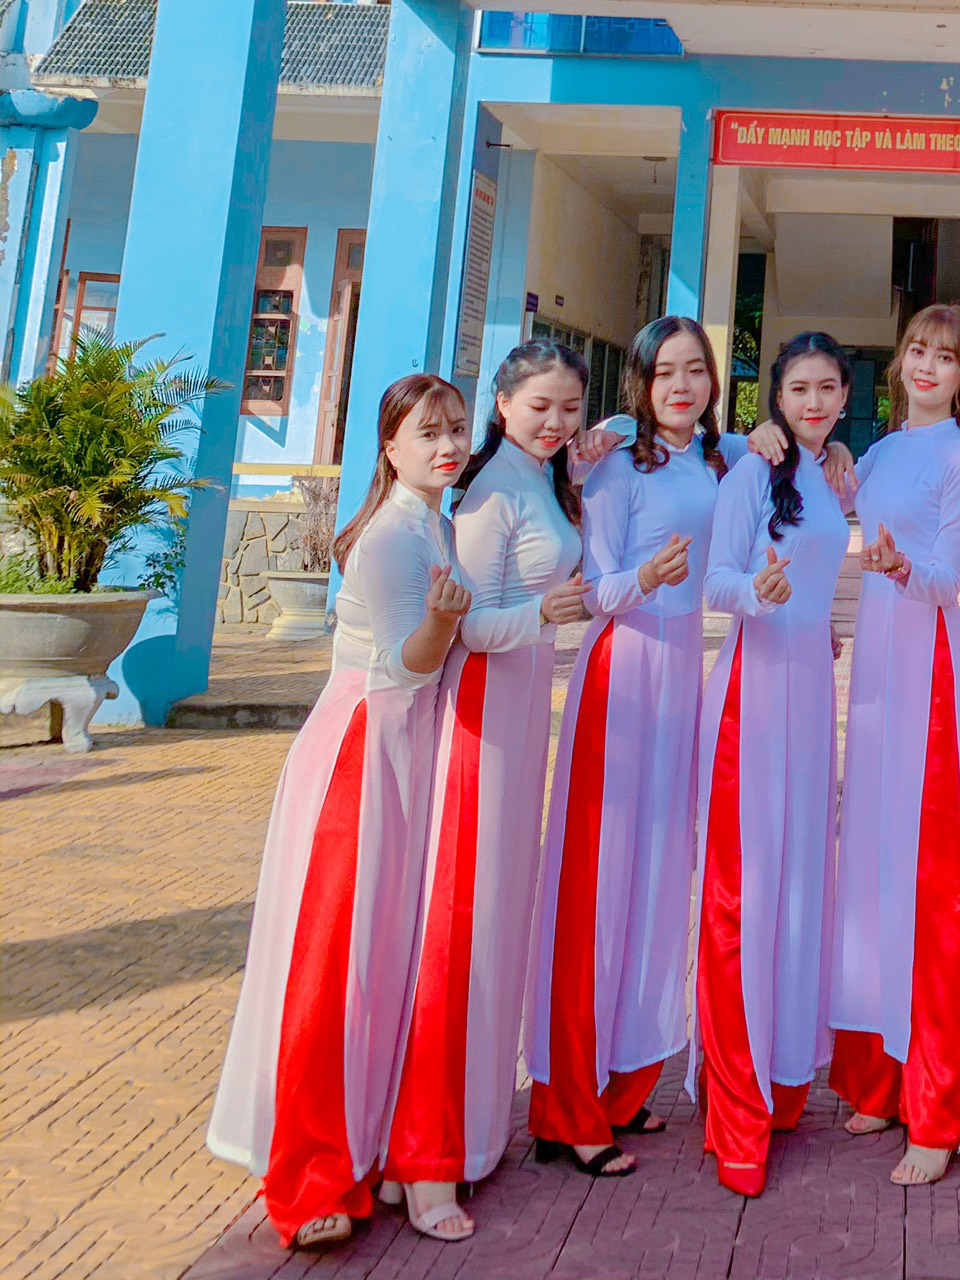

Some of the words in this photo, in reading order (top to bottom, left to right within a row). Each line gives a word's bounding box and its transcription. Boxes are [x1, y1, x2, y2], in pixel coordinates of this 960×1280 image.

[768, 127, 811, 149] MẠNH
[813, 129, 842, 151] HỌC
[845, 127, 872, 152] TẬP
[874, 128, 893, 149] VÀ
[896, 129, 926, 150] LÀM
